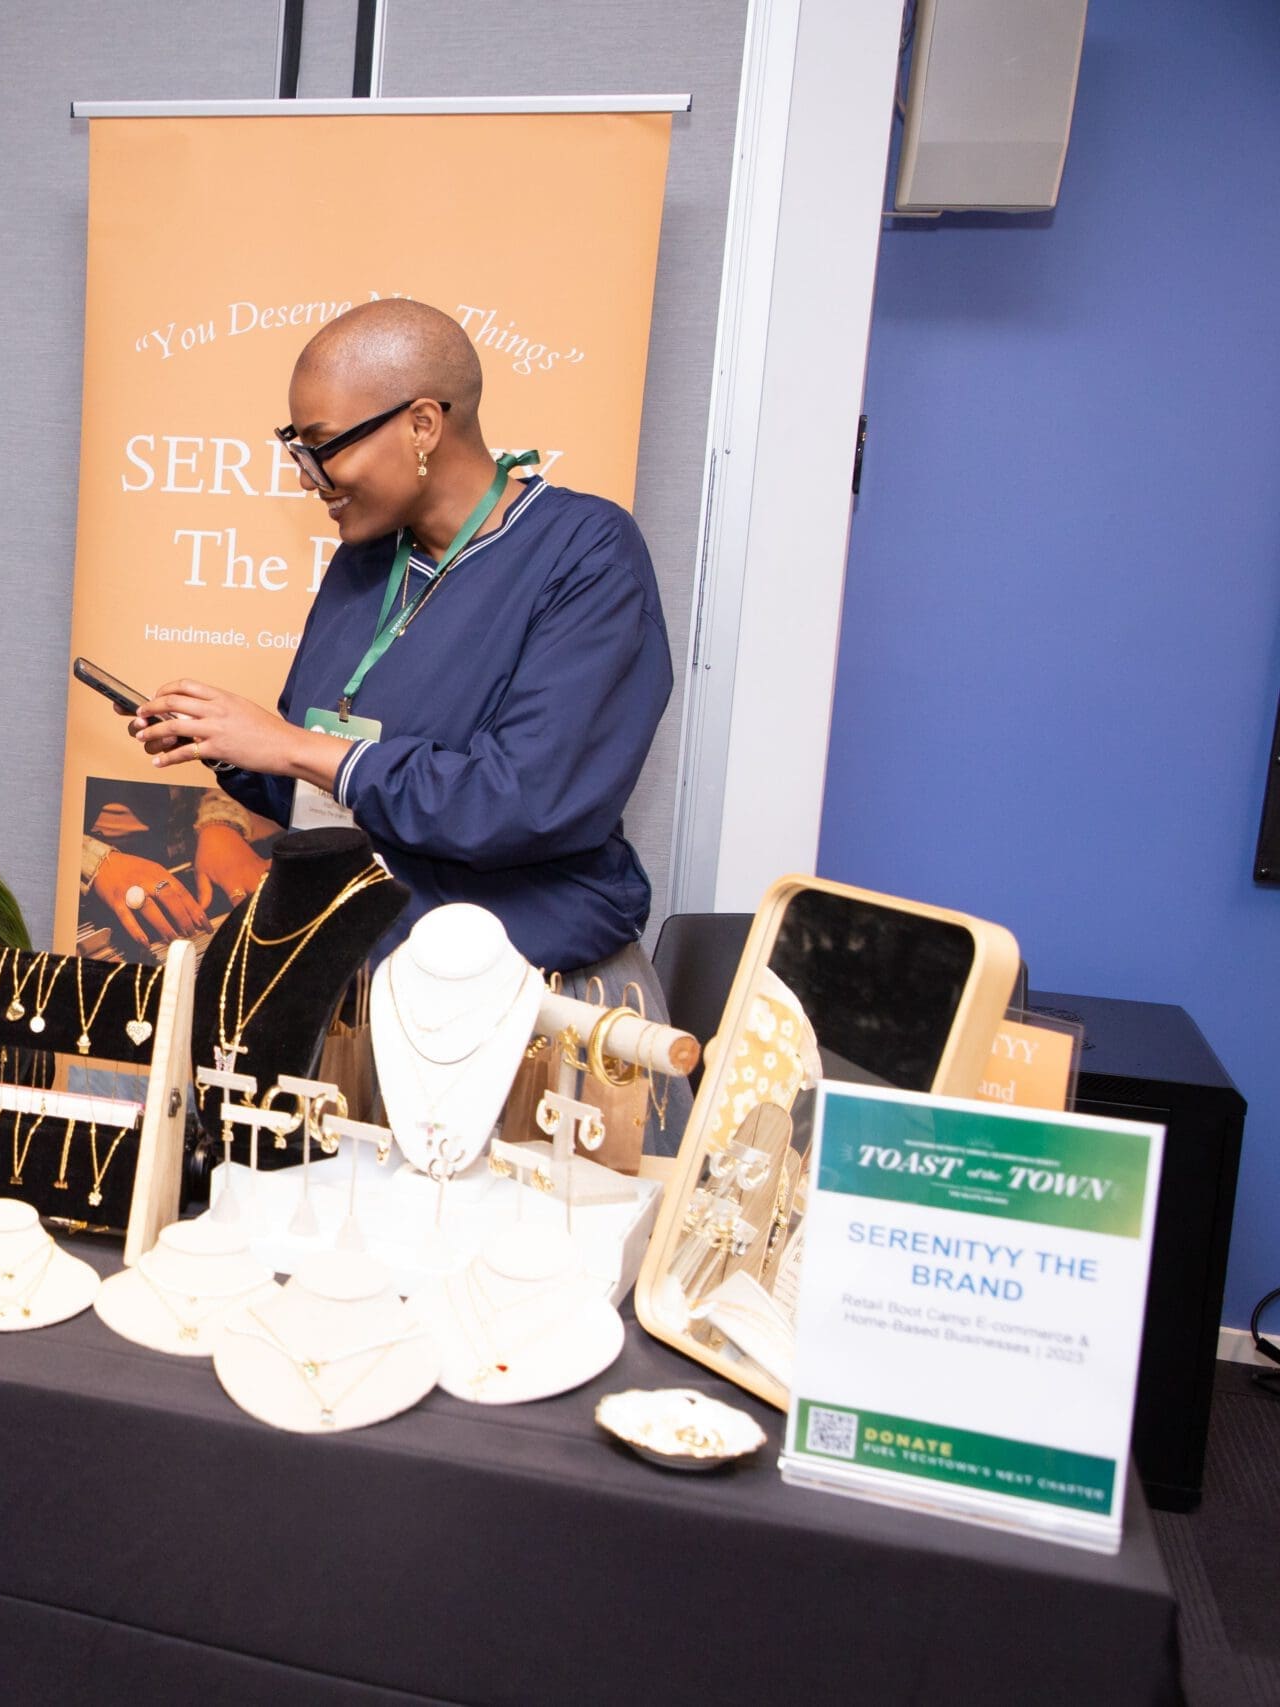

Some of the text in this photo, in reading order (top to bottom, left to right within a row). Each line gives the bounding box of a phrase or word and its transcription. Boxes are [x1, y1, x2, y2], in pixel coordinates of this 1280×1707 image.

[227, 301, 352, 336] Deserve
[174, 528, 288, 591] The
[144, 624, 250, 649] Handmade,
[857, 1144, 965, 1180] TOAST
[1007, 1165, 1112, 1202] TOWN
[847, 1221, 1099, 1283] SERENITYY THE
[911, 1264, 1024, 1302] BRAND
[888, 1301, 922, 1318] Boot
[926, 1308, 971, 1328] Camp
[862, 1443, 897, 1459] FUEL
[864, 1427, 953, 1457] DONATE
